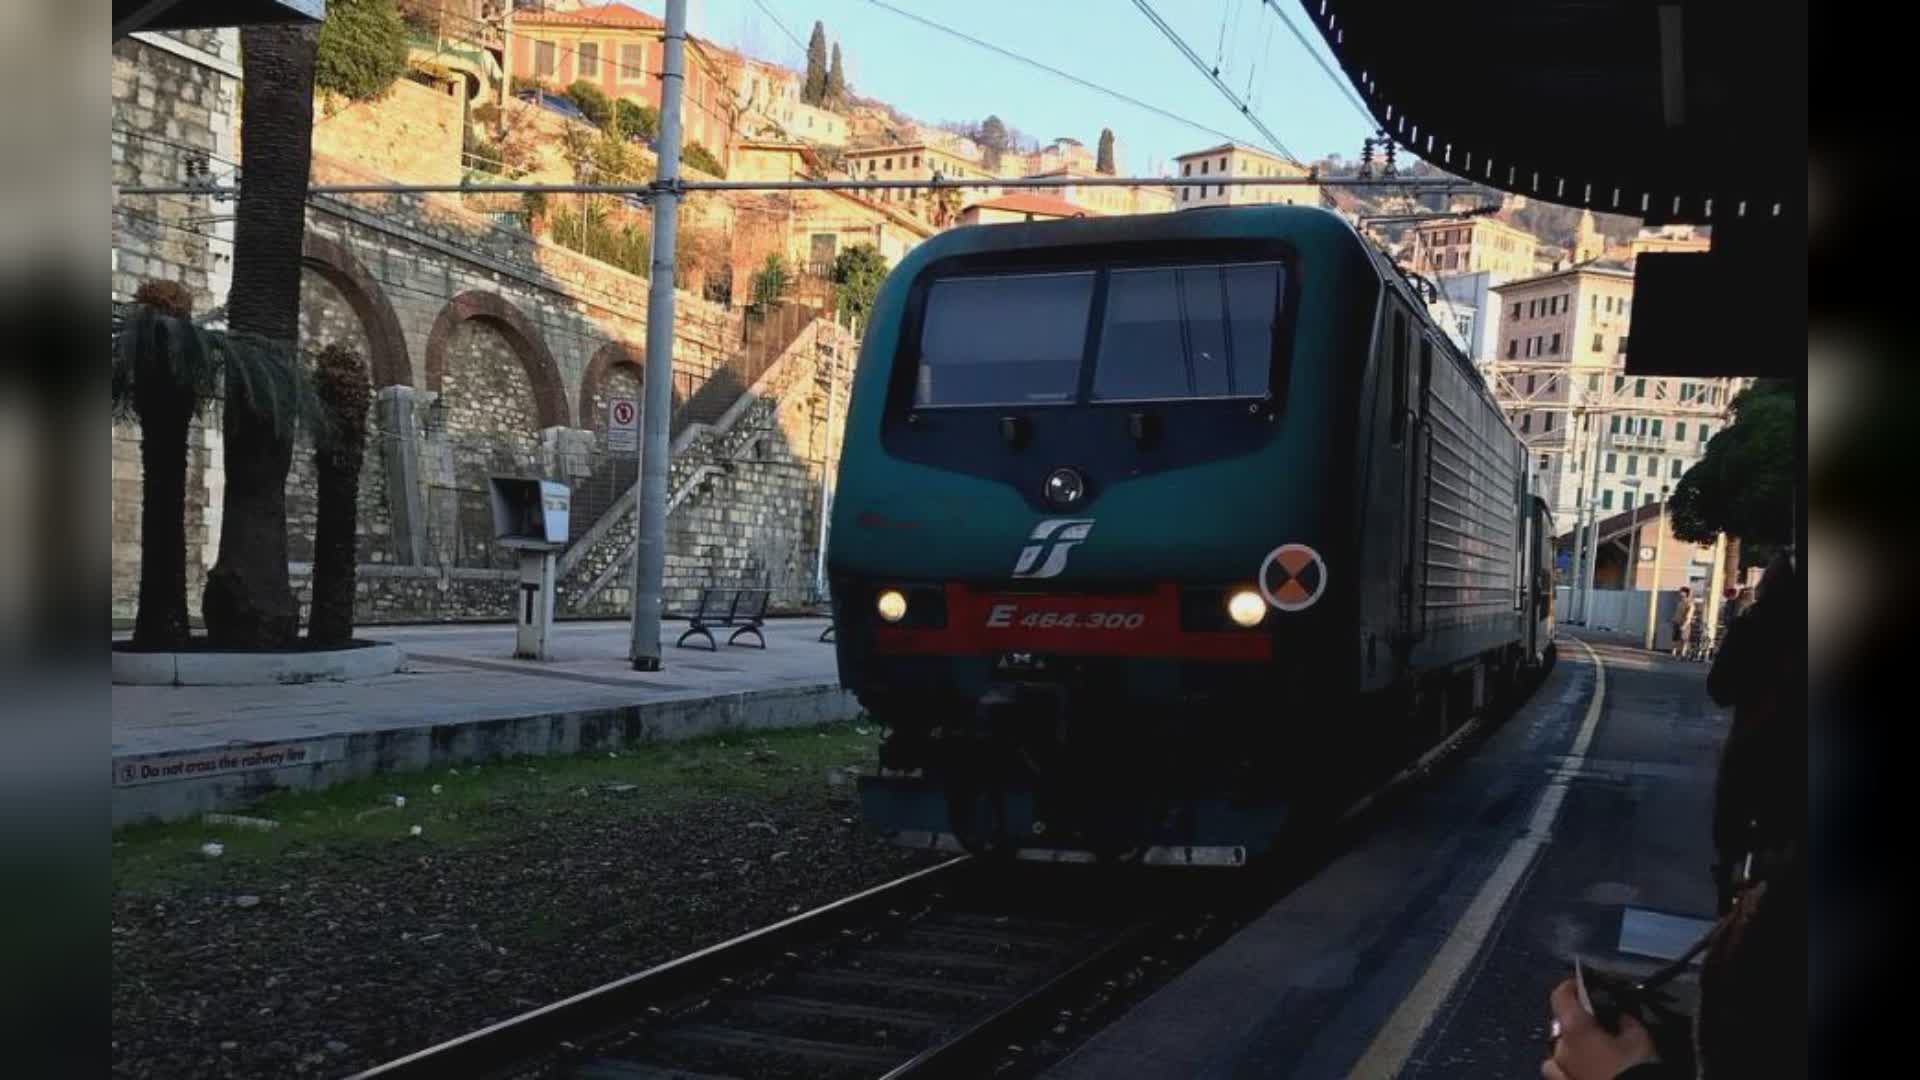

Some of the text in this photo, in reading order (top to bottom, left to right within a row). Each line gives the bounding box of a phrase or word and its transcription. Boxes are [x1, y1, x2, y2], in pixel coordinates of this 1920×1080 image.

[985, 604, 1145, 628] E 464.300
[141, 747, 307, 779] Do not cross the railway line
